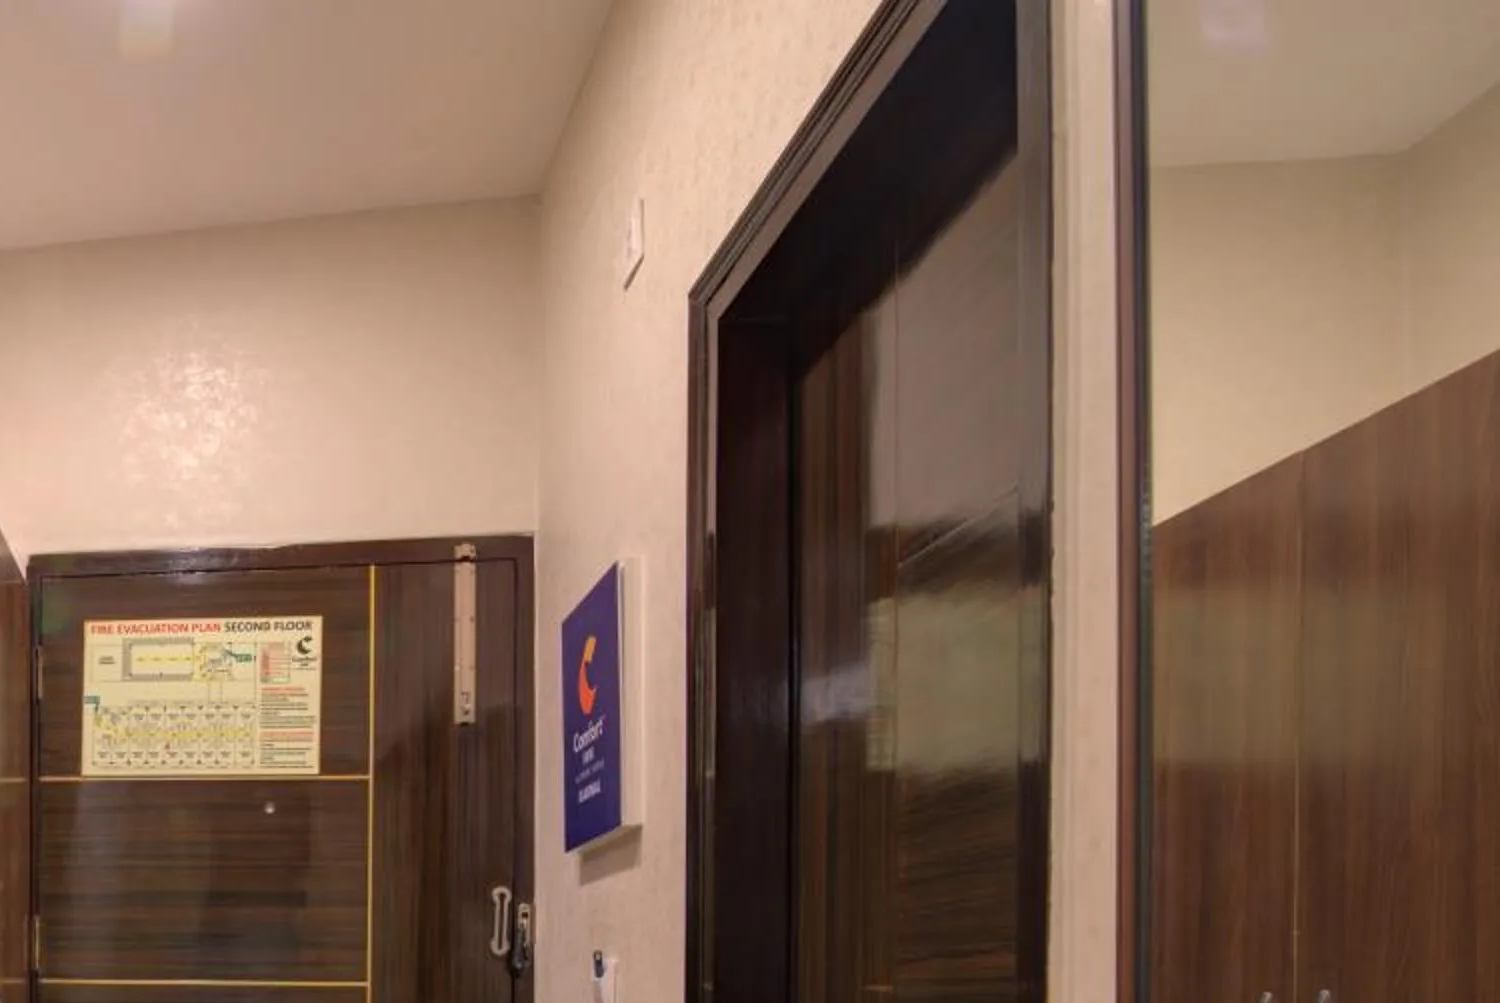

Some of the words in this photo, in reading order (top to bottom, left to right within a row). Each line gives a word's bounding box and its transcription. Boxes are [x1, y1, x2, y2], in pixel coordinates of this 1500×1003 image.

[116, 623, 189, 634] EVACUATION
[191, 622, 221, 633] PLAN
[224, 621, 271, 632] SECOND
[274, 620, 313, 631] FLOOR
[574, 719, 603, 752] Comfort
